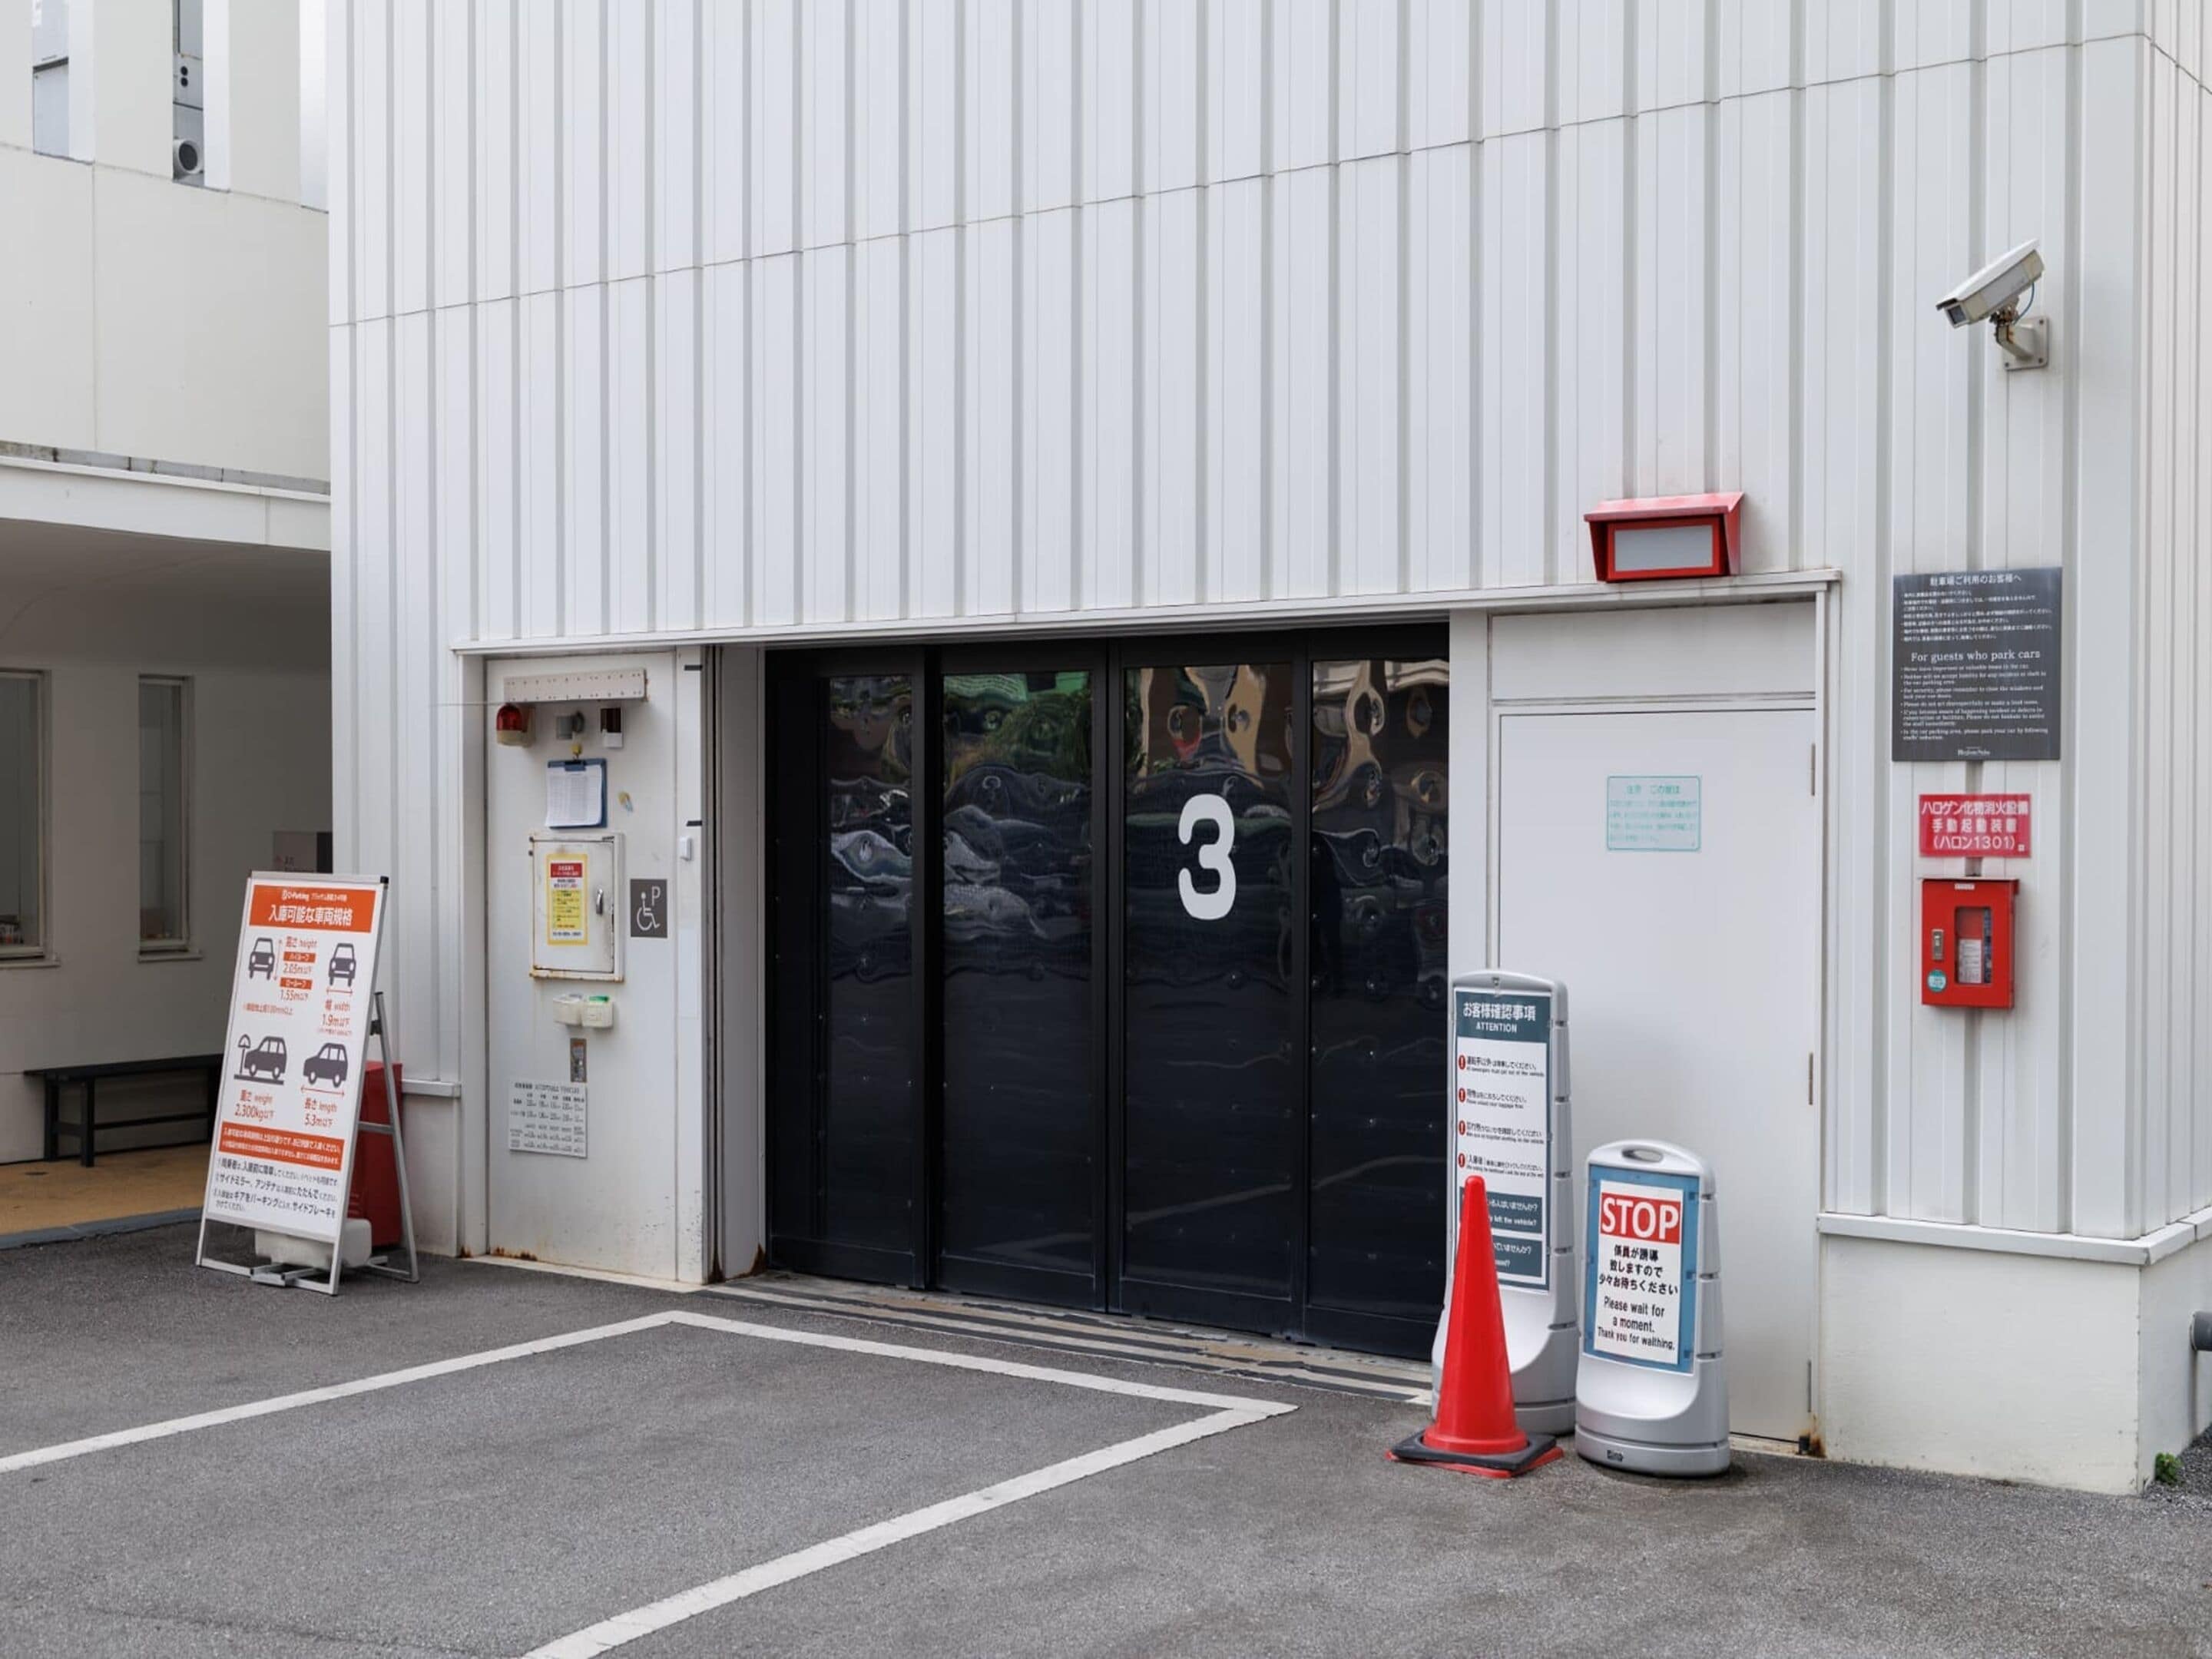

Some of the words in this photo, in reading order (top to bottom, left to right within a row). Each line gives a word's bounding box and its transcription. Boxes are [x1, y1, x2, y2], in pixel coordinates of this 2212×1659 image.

[1911, 652, 1929, 661] For
[1931, 652, 1963, 664] guests
[1967, 650, 1988, 661] who
[1991, 649, 2015, 661] park
[2018, 650, 2040, 659] cars
[1921, 800, 2028, 816] ハロゲン化物消火設備
[1932, 817, 2018, 833] 手動起動装置
[1178, 793, 1236, 920] 3
[651, 886, 661, 907] P
[268, 904, 353, 927] 入庫可能な車両規格
[322, 1013, 350, 1027] 1.9m以下
[1463, 1002, 1535, 1022] お客様確認事項
[1475, 1022, 1517, 1033] ATTENTION
[305, 1114, 333, 1128] 5.3m以下
[1504, 1216, 1512, 1225] the
[1601, 1197, 1680, 1240] STOP
[1614, 1243, 1659, 1263] 係員が誘導
[1610, 1259, 1663, 1279] 致しますので
[1599, 1273, 1678, 1296] 少々お待ちください
[1604, 1296, 1628, 1312] Please
[1630, 1301, 1648, 1316] wait
[1651, 1303, 1665, 1318] for
[1612, 1316, 1618, 1326] a
[1619, 1317, 1655, 1333] moment.
[1598, 1326, 1614, 1339] Thank
[1616, 1331, 1628, 1343] you
[1629, 1333, 1640, 1344] for
